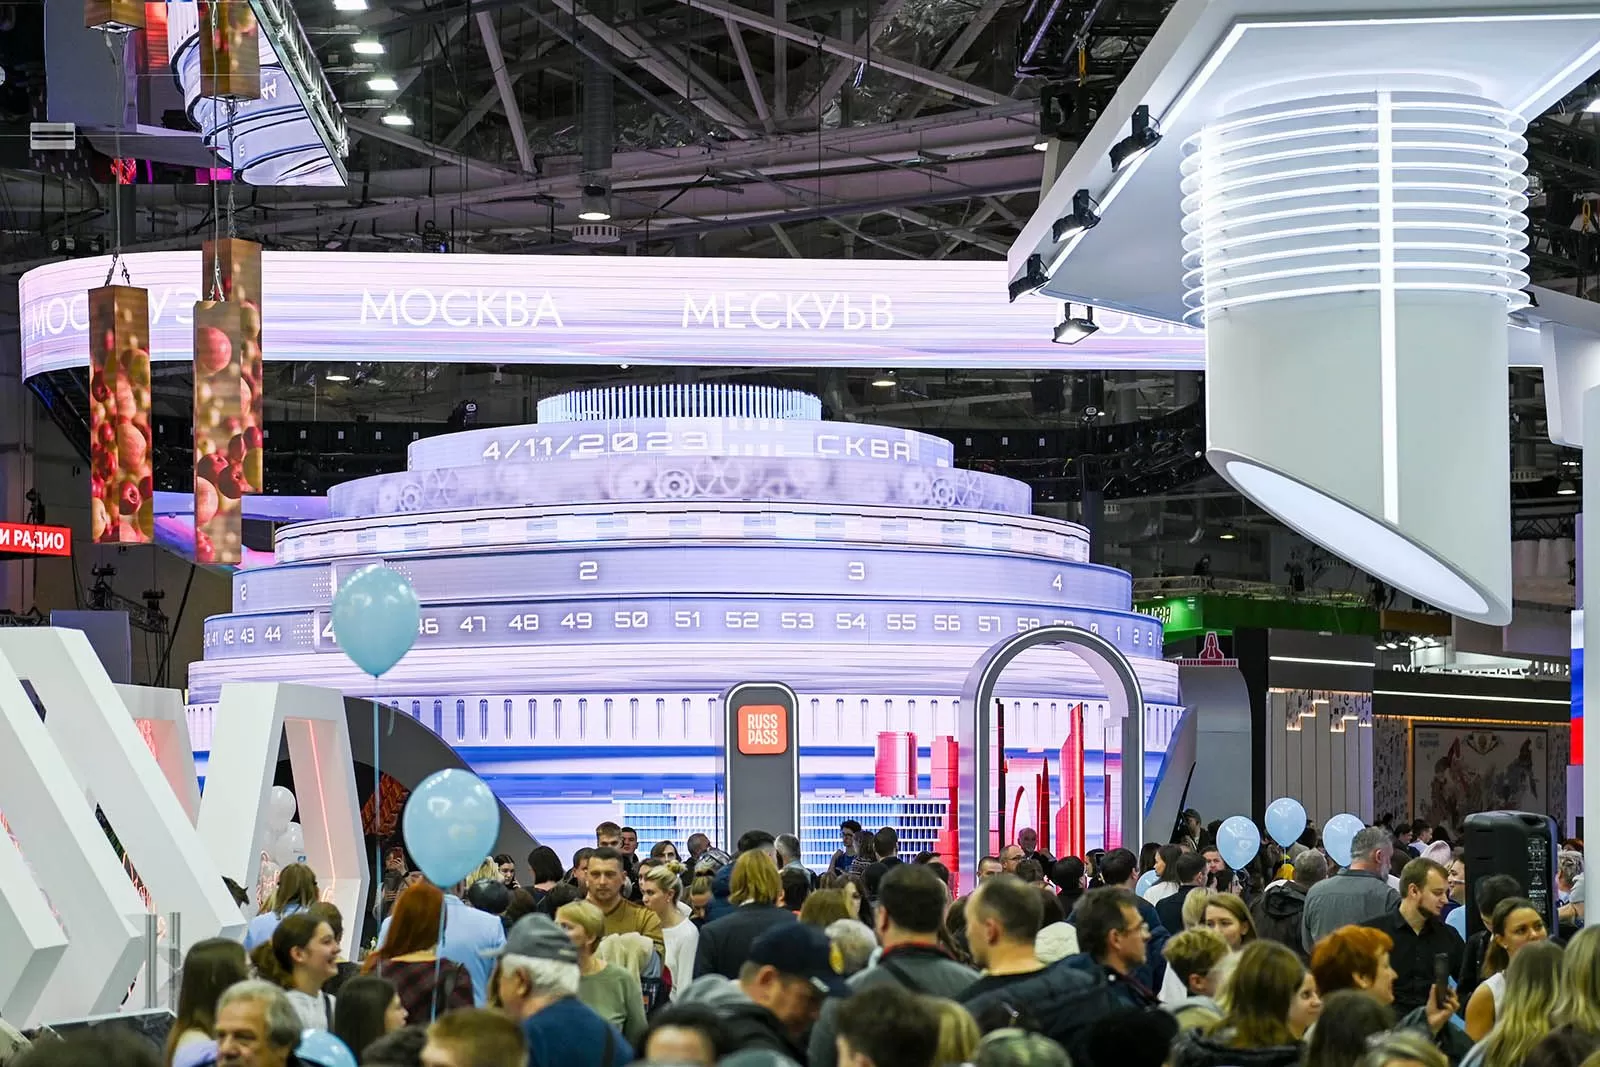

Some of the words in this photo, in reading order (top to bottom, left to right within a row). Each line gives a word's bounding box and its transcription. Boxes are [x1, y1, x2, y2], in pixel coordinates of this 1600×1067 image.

[360, 288, 564, 328] МОСКВА
[681, 291, 894, 331] МЕСКУЬВ
[483, 431, 708, 461] 4/11/2023
[14, 529, 65, 551] РАДИО
[579, 560, 598, 580] 2
[848, 561, 865, 580] 3
[1052, 574, 1063, 591] 4
[240, 627, 255, 643] 43
[264, 626, 281, 641] 44
[321, 619, 337, 643] 4
[459, 616, 486, 632] 47
[508, 614, 539, 631] 48
[560, 612, 593, 629] 49
[614, 611, 648, 628] 50
[675, 611, 701, 628] 51
[725, 611, 760, 629] 52
[781, 612, 814, 629] 53
[836, 613, 866, 630] 54
[887, 613, 916, 630] 55
[934, 614, 961, 631] 56
[978, 615, 1001, 632] 57
[1116, 625, 1121, 641] 1
[1133, 628, 1140, 644] 2
[1147, 631, 1153, 646] 3
[747, 713, 778, 729] RUSS
[747, 729, 778, 745] PASS
